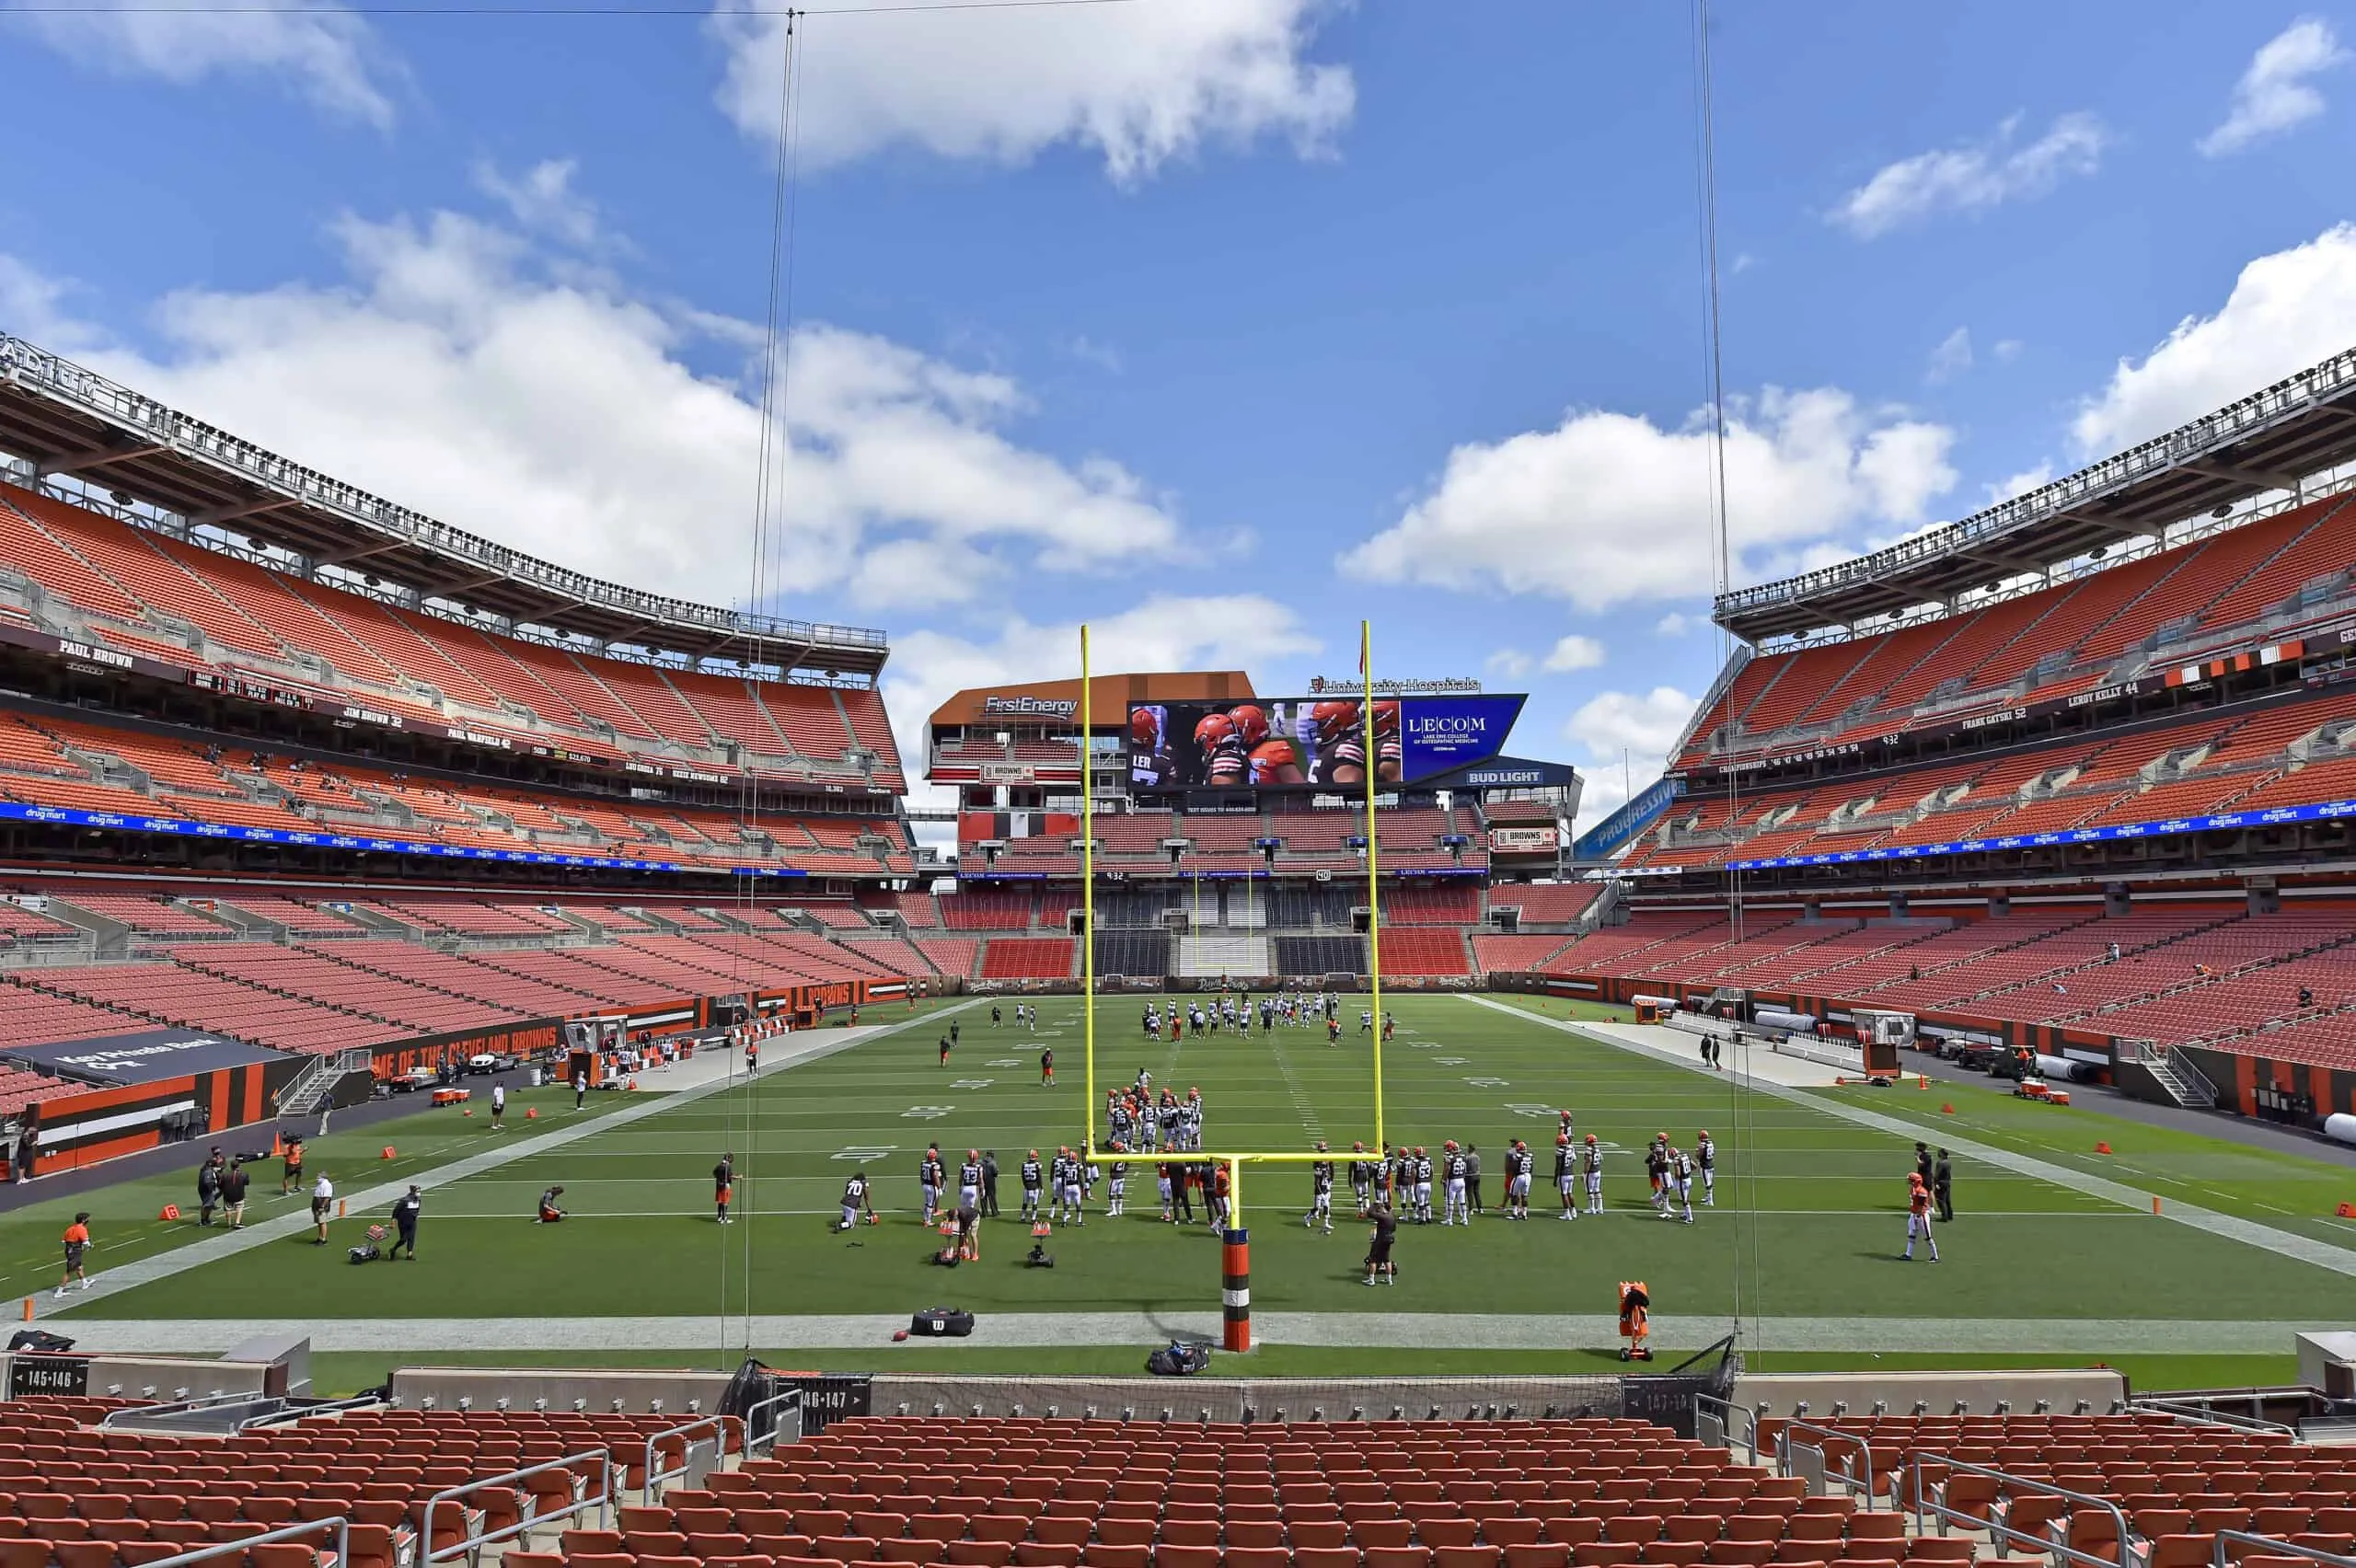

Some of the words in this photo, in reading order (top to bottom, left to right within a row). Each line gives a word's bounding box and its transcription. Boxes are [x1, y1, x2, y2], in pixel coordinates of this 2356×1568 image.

[59, 640, 91, 659] PAUL
[93, 647, 133, 669] BROWN
[1406, 677, 1481, 694] Hospitals
[2068, 692, 2094, 708] LEROY
[2095, 686, 2122, 701] KELLY
[2125, 681, 2139, 695] 44
[986, 697, 1079, 716] FirstEnergy
[343, 707, 361, 719] JIM
[361, 709, 389, 724] BROWN
[390, 715, 402, 728] 32
[1962, 717, 1985, 730] FRANK
[2015, 707, 2027, 720] 52
[994, 766, 1022, 774] BROWNS
[1469, 772, 1497, 783] BUD
[1499, 771, 1541, 782] LIGHT
[26, 808, 45, 820] drug
[46, 812, 66, 820] mart
[2319, 806, 2338, 816] drug
[2339, 803, 2356, 813] mart
[88, 815, 106, 825] drug
[2209, 818, 2224, 827] drug
[2262, 813, 2279, 822] drug
[144, 821, 161, 831] drug
[197, 825, 212, 836] drug
[2159, 824, 2174, 832] drug
[1509, 831, 1541, 839] BROWNS
[1106, 871, 1123, 881] 9:32
[52, 1054, 109, 1065] Key
[96, 1044, 174, 1059] Private
[163, 1038, 222, 1050] Bank
[448, 1032, 509, 1066] CLEVELAND
[512, 1026, 558, 1052] BROWNS
[398, 1049, 415, 1076] OF
[419, 1044, 445, 1068] THE
[830, 1145, 899, 1159] 10
[921, 1167, 931, 1181] 31
[1419, 1166, 1431, 1179] 63
[847, 1182, 863, 1196] 70
[167, 1206, 178, 1217] G
